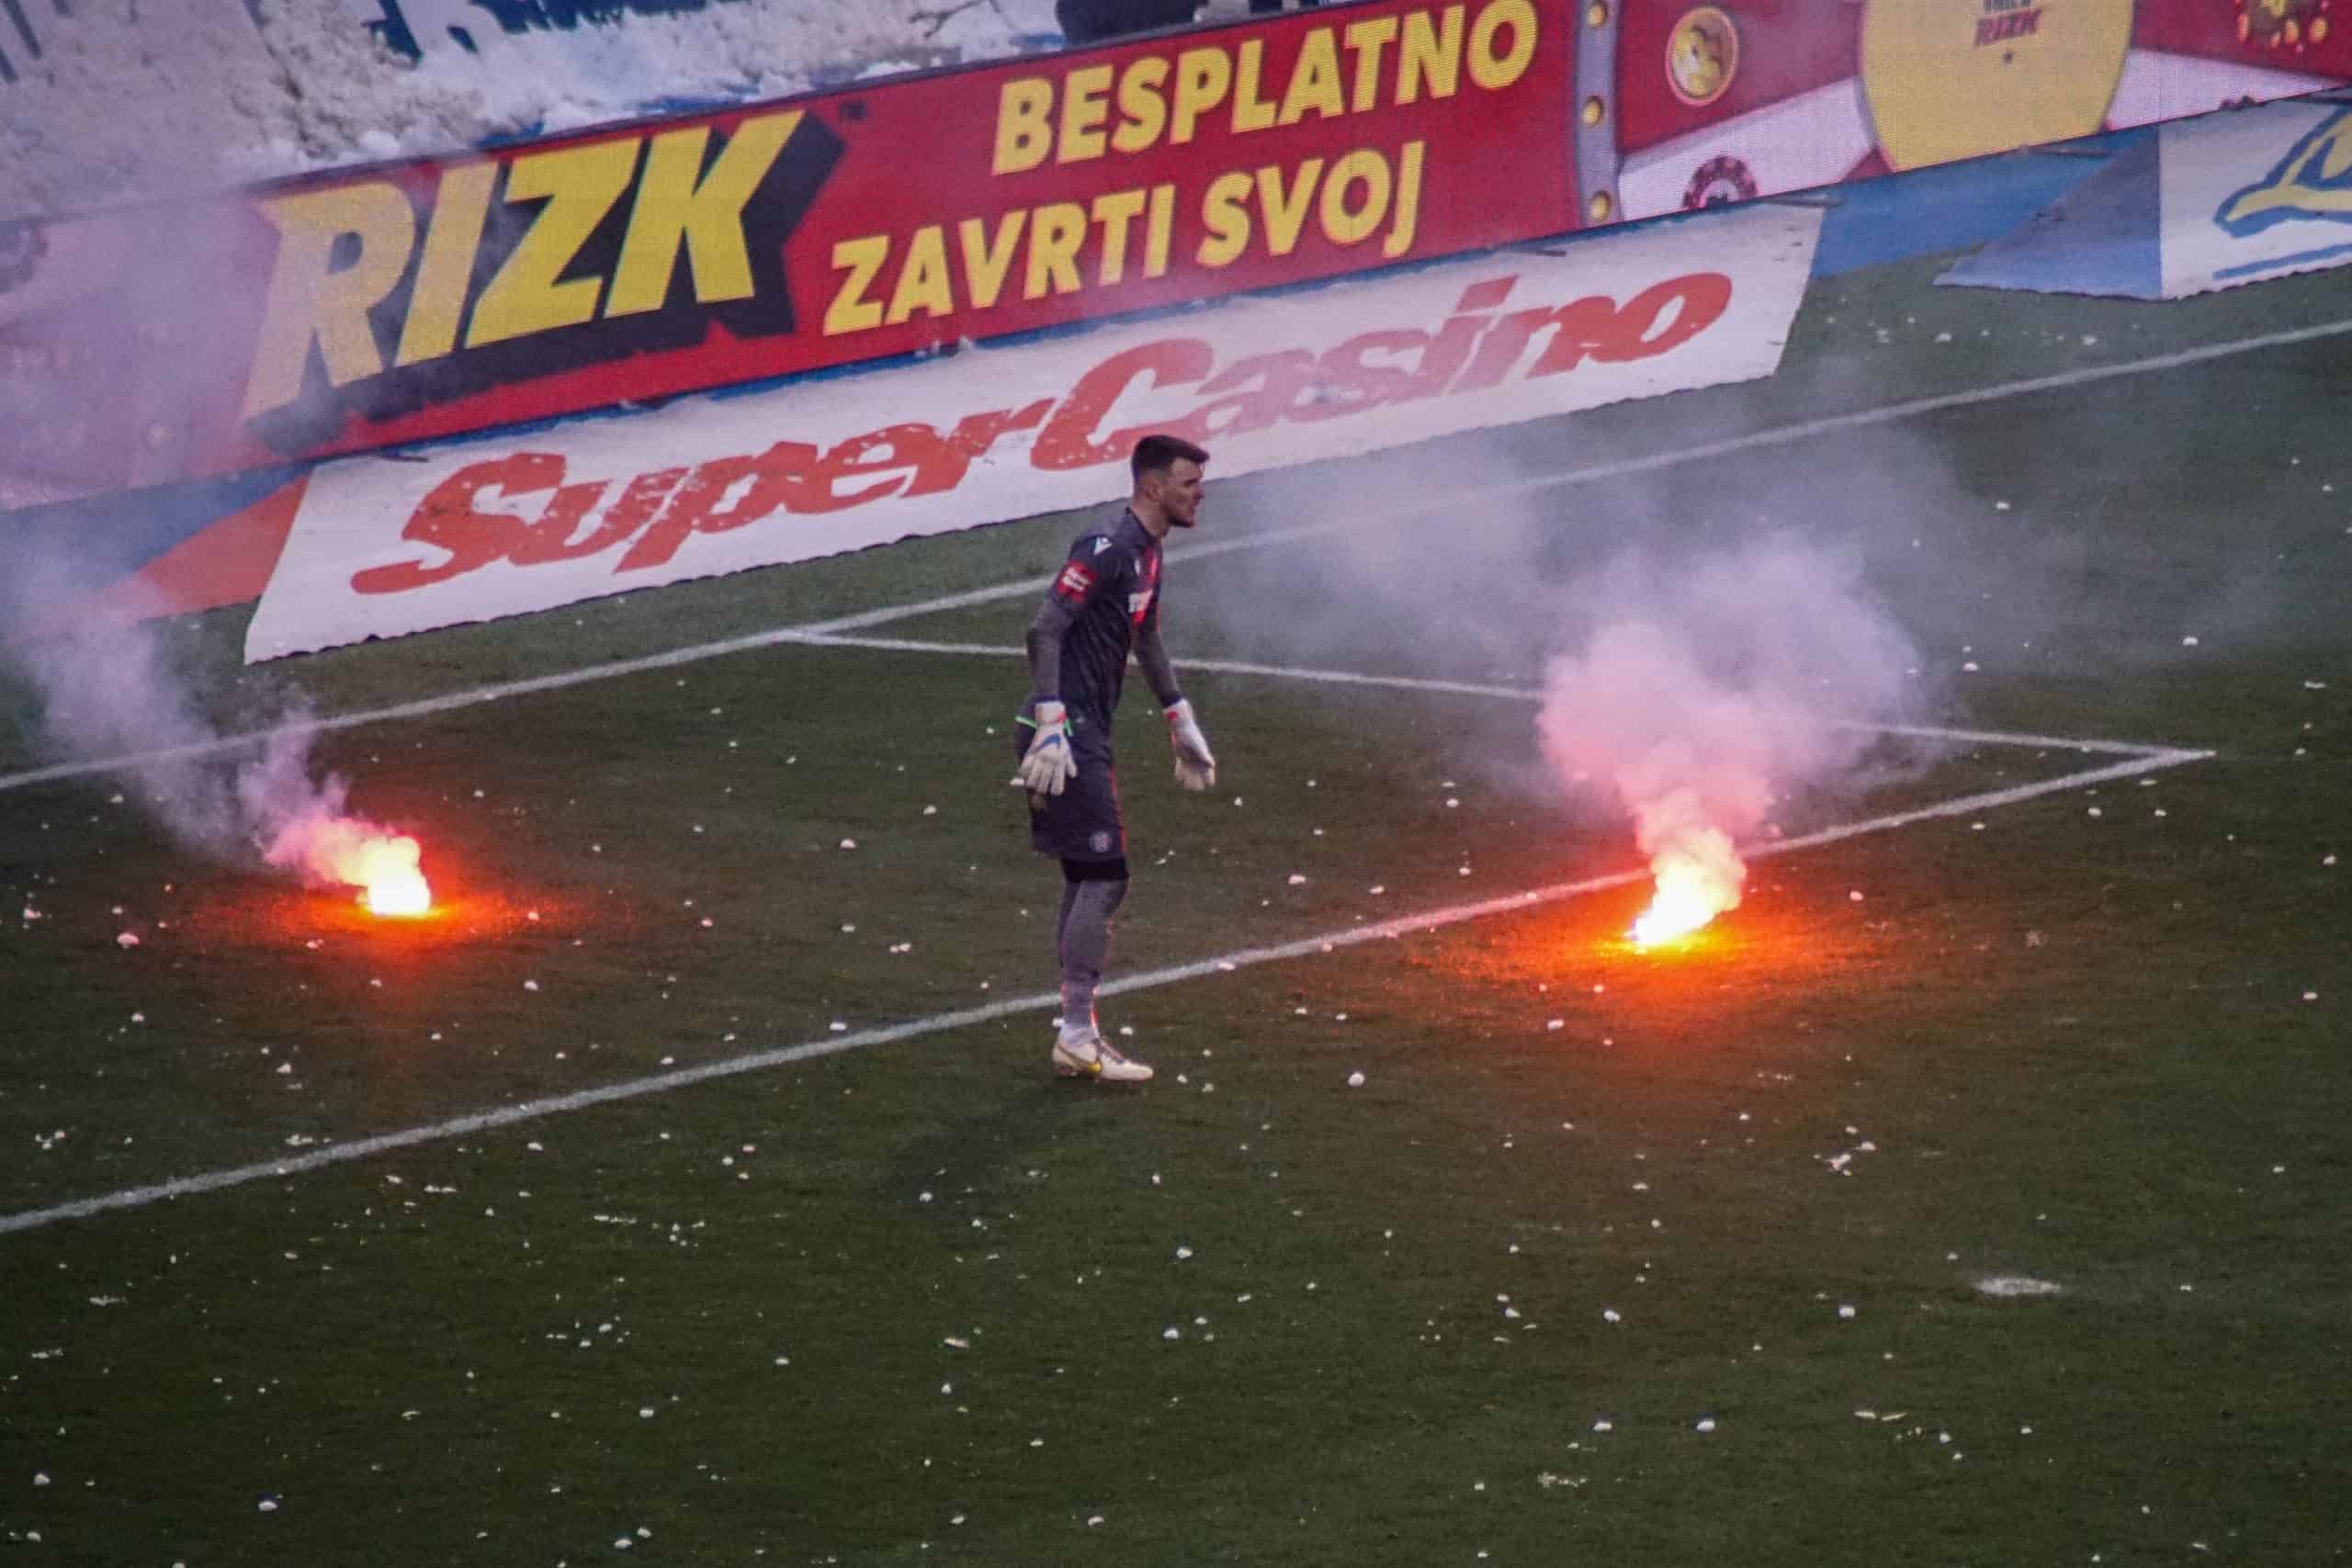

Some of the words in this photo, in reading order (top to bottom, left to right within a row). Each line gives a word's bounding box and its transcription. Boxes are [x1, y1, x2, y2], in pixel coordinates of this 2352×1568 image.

[992, 0, 1538, 175] BESPLATNO
[242, 109, 807, 420] RIZK
[822, 184, 1177, 337] ZAVRTI
[1194, 140, 1427, 267] SVOJ
